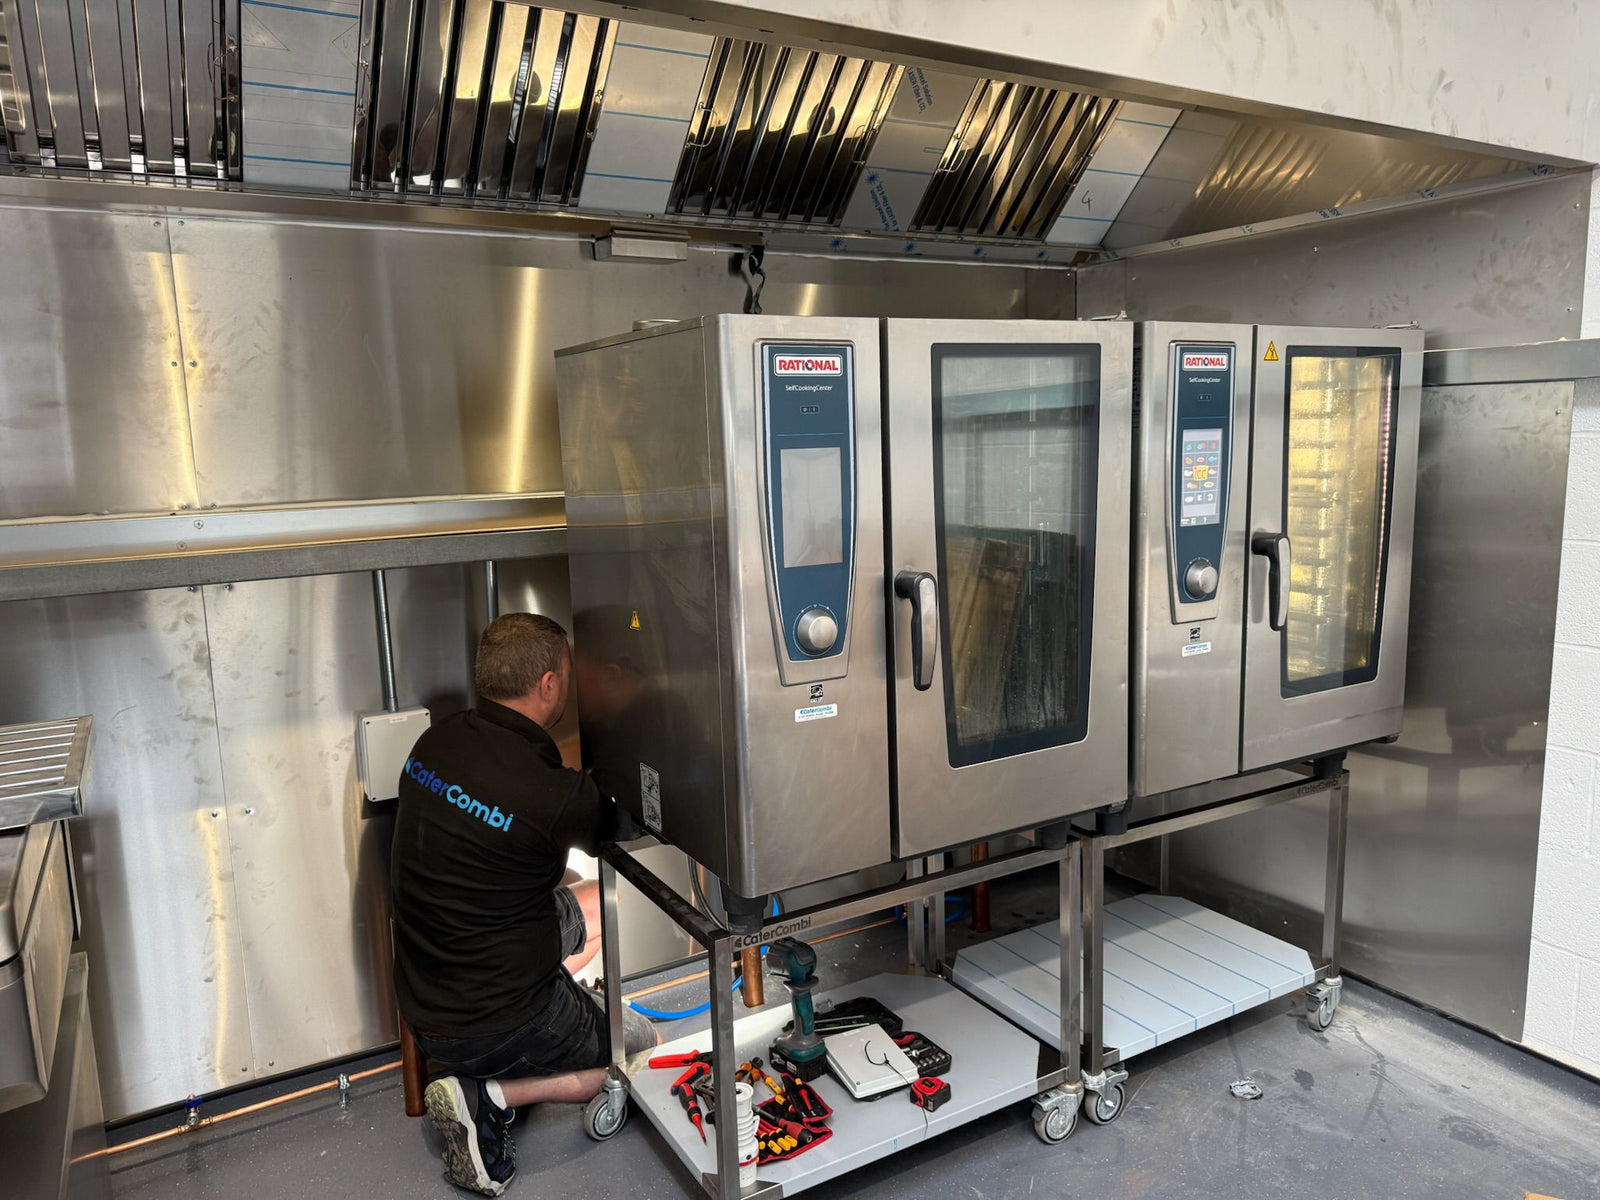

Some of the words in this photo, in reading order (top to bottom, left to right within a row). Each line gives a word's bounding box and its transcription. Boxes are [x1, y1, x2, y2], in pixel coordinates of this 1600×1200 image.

[778, 358, 838, 371] RATIONAL
[1185, 357, 1225, 367] RATIONAL
[785, 385, 833, 393] SelfCookingCenter
[410, 760, 514, 832] CaterCombi
[743, 916, 811, 946] CaterCombi
